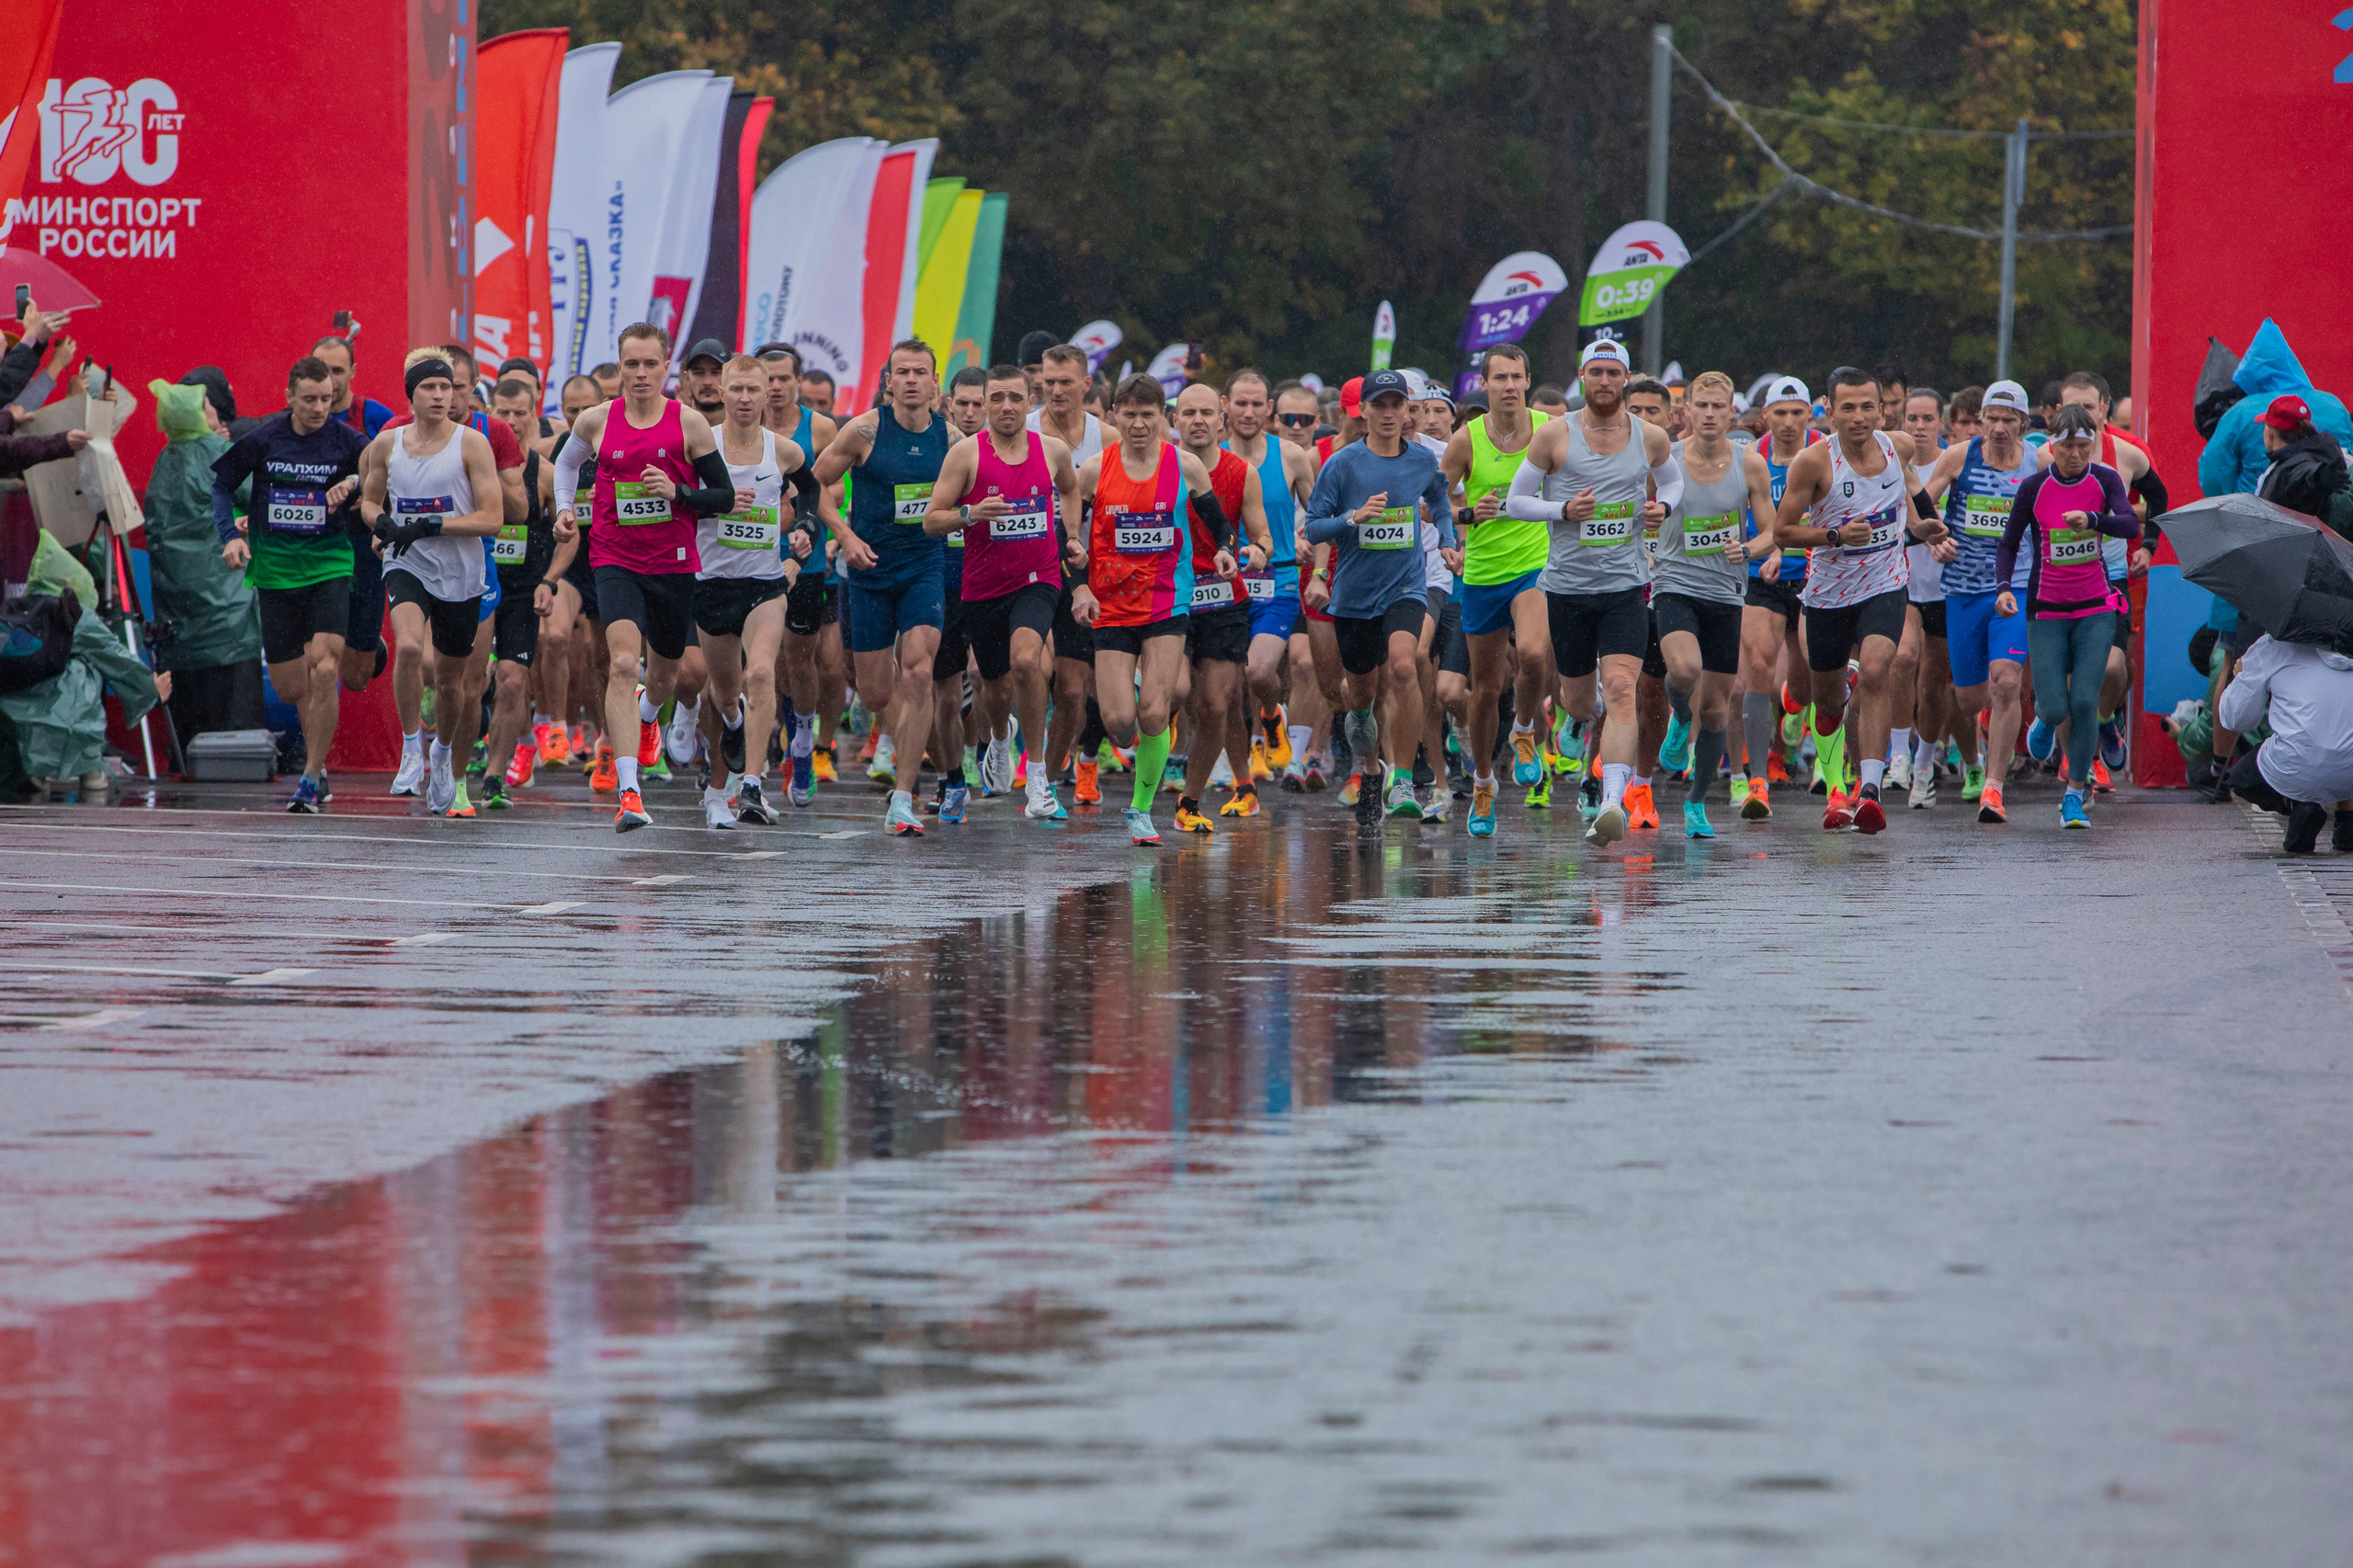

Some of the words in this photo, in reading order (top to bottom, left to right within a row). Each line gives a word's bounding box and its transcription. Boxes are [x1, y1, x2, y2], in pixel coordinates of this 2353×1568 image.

[148, 114, 185, 131] ЛЕТ
[15, 197, 201, 227] МИНСПОРТ
[40, 229, 176, 258] РОССИИ
[1624, 253, 1648, 267] ANTA
[1597, 278, 1654, 308] 0:39
[1479, 304, 1529, 335] 1:24
[266, 461, 337, 474] УРАЛХИМ
[274, 507, 313, 521] 6026
[623, 499, 666, 515] 4533
[902, 500, 931, 515] 477
[996, 517, 1037, 532] 6243
[1971, 513, 2008, 528] 3696
[723, 523, 765, 540] 3525
[1364, 527, 1404, 540] 4074
[1586, 522, 1625, 536] 3662
[1870, 529, 1888, 543] 33
[1121, 531, 1162, 544] 5924
[2055, 541, 2095, 557] 3046
[1192, 587, 1220, 601] 910
